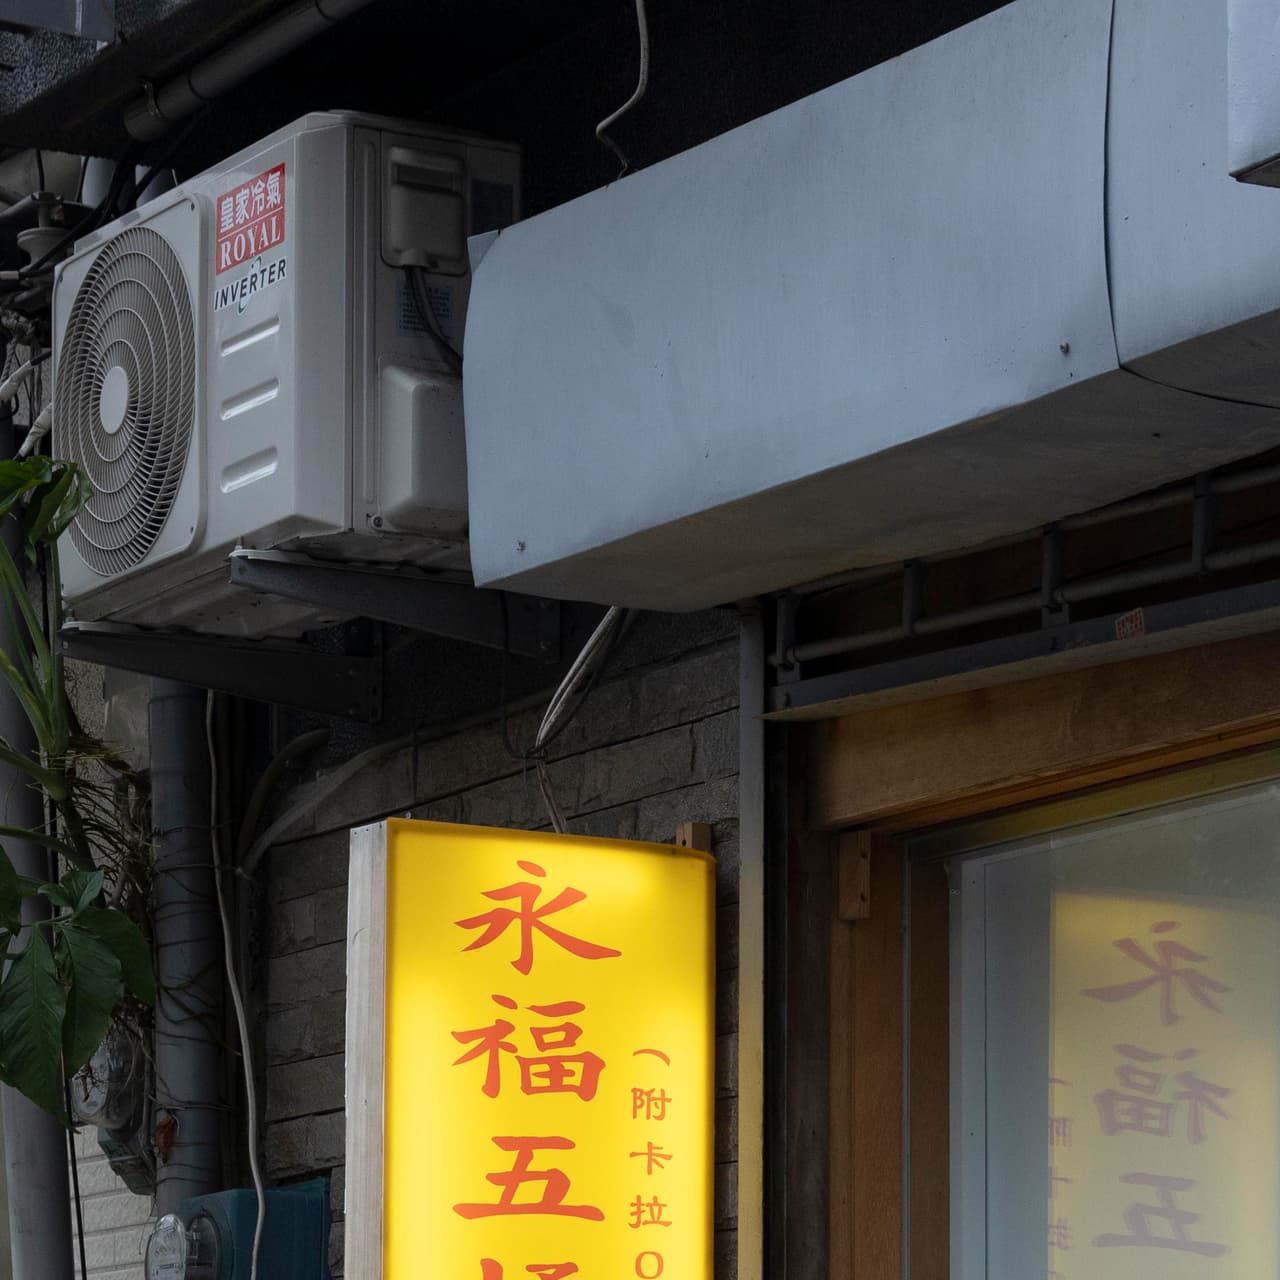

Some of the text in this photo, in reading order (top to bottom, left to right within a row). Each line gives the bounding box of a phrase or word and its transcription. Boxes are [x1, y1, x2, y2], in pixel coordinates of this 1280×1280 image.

[219, 170, 282, 233] 皇家冷氣
[219, 215, 282, 271] ROYAL
[215, 259, 287, 311] INVERTER
